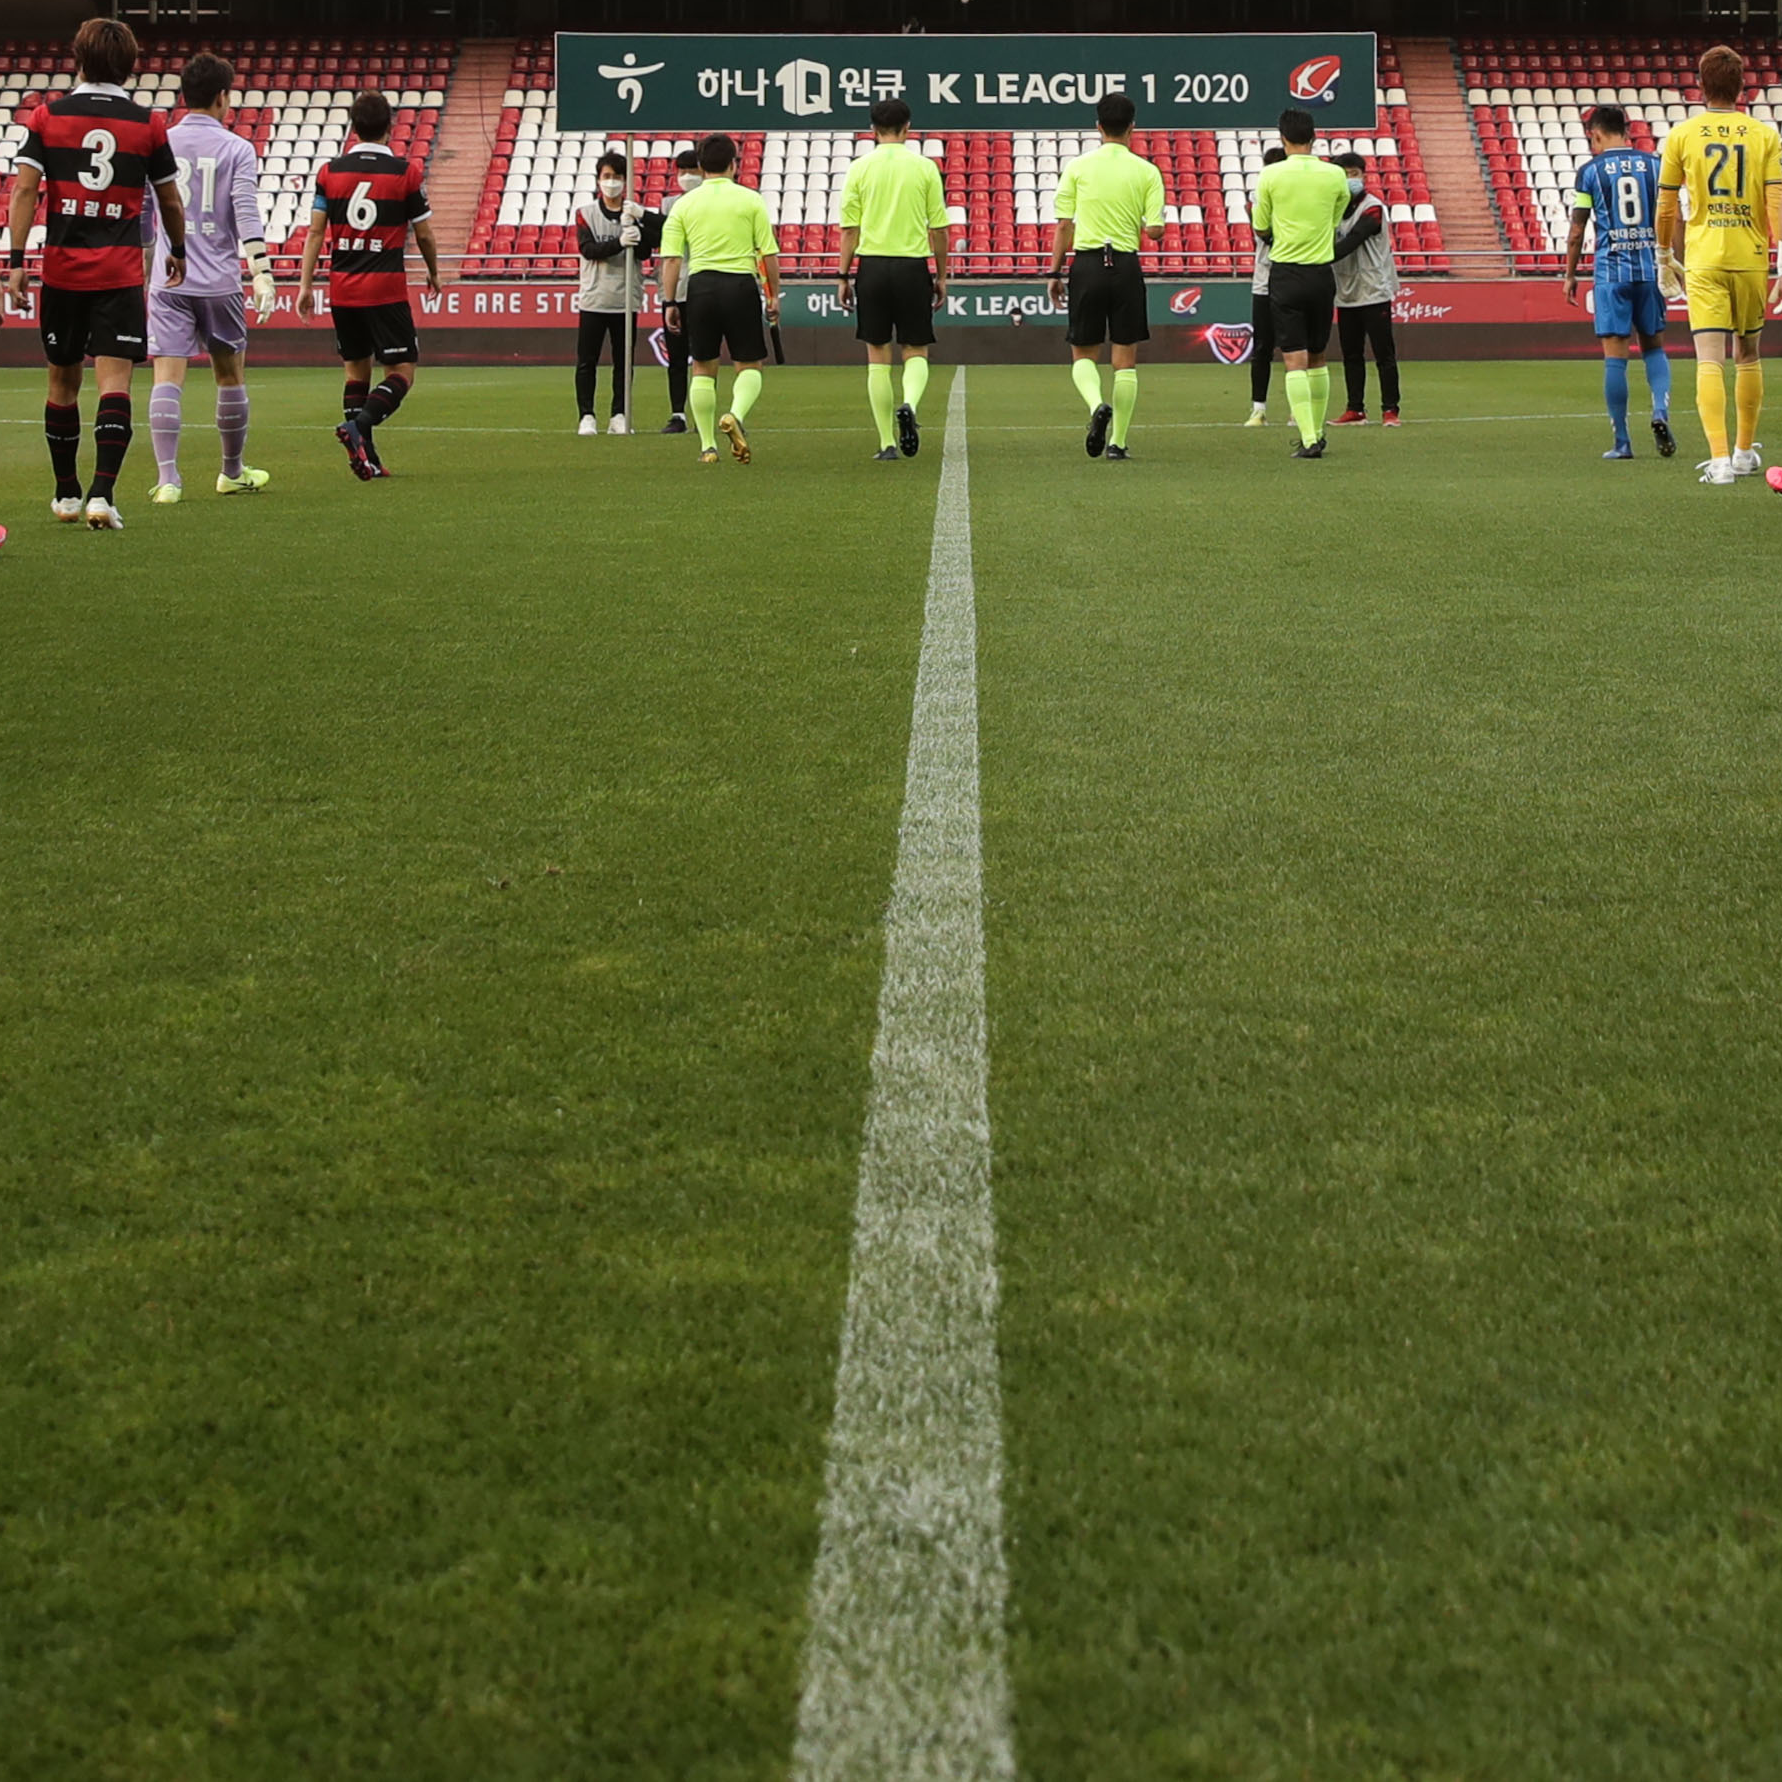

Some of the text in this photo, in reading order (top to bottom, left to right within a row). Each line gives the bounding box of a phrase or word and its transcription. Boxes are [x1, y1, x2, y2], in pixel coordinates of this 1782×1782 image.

[697, 68, 769, 106] 하나
[838, 68, 906, 107] 원큐
[928, 74, 960, 103] K
[975, 73, 1126, 104] LEAGUE
[1141, 74, 1156, 102] 1
[1174, 74, 1249, 102] 2020
[1699, 125, 1748, 137] 조현우
[77, 129, 117, 191] 3
[1604, 160, 1647, 175] 신진호
[1705, 143, 1745, 198] 21
[61, 198, 123, 220] 김광석
[347, 181, 378, 231] 6
[1617, 176, 1643, 226] 8
[421, 293, 460, 314] WE
[474, 292, 521, 313] ARE
[948, 295, 1069, 317] K LEAGU
